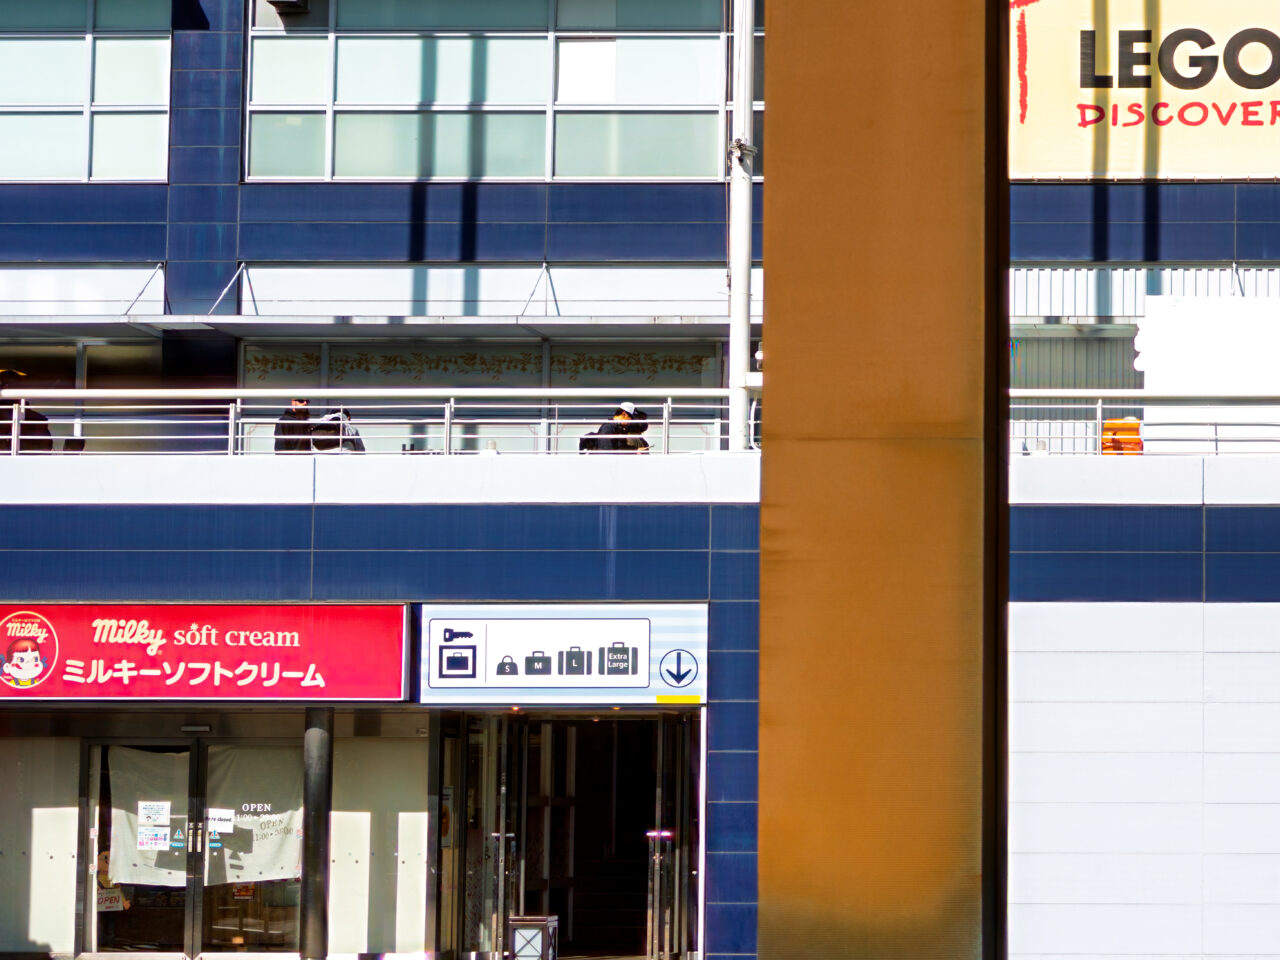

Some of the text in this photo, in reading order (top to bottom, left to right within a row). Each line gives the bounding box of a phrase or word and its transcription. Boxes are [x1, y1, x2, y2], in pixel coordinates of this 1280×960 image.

[6, 622, 49, 644] Milky
[92, 618, 300, 656] Milky soft cream
[534, 662, 543, 670] M
[572, 659, 578, 667] L
[608, 661, 629, 669] Large
[505, 665, 510, 673] S
[62, 659, 326, 688] ミルキーソフトクリーム
[242, 803, 271, 812] OPEN
